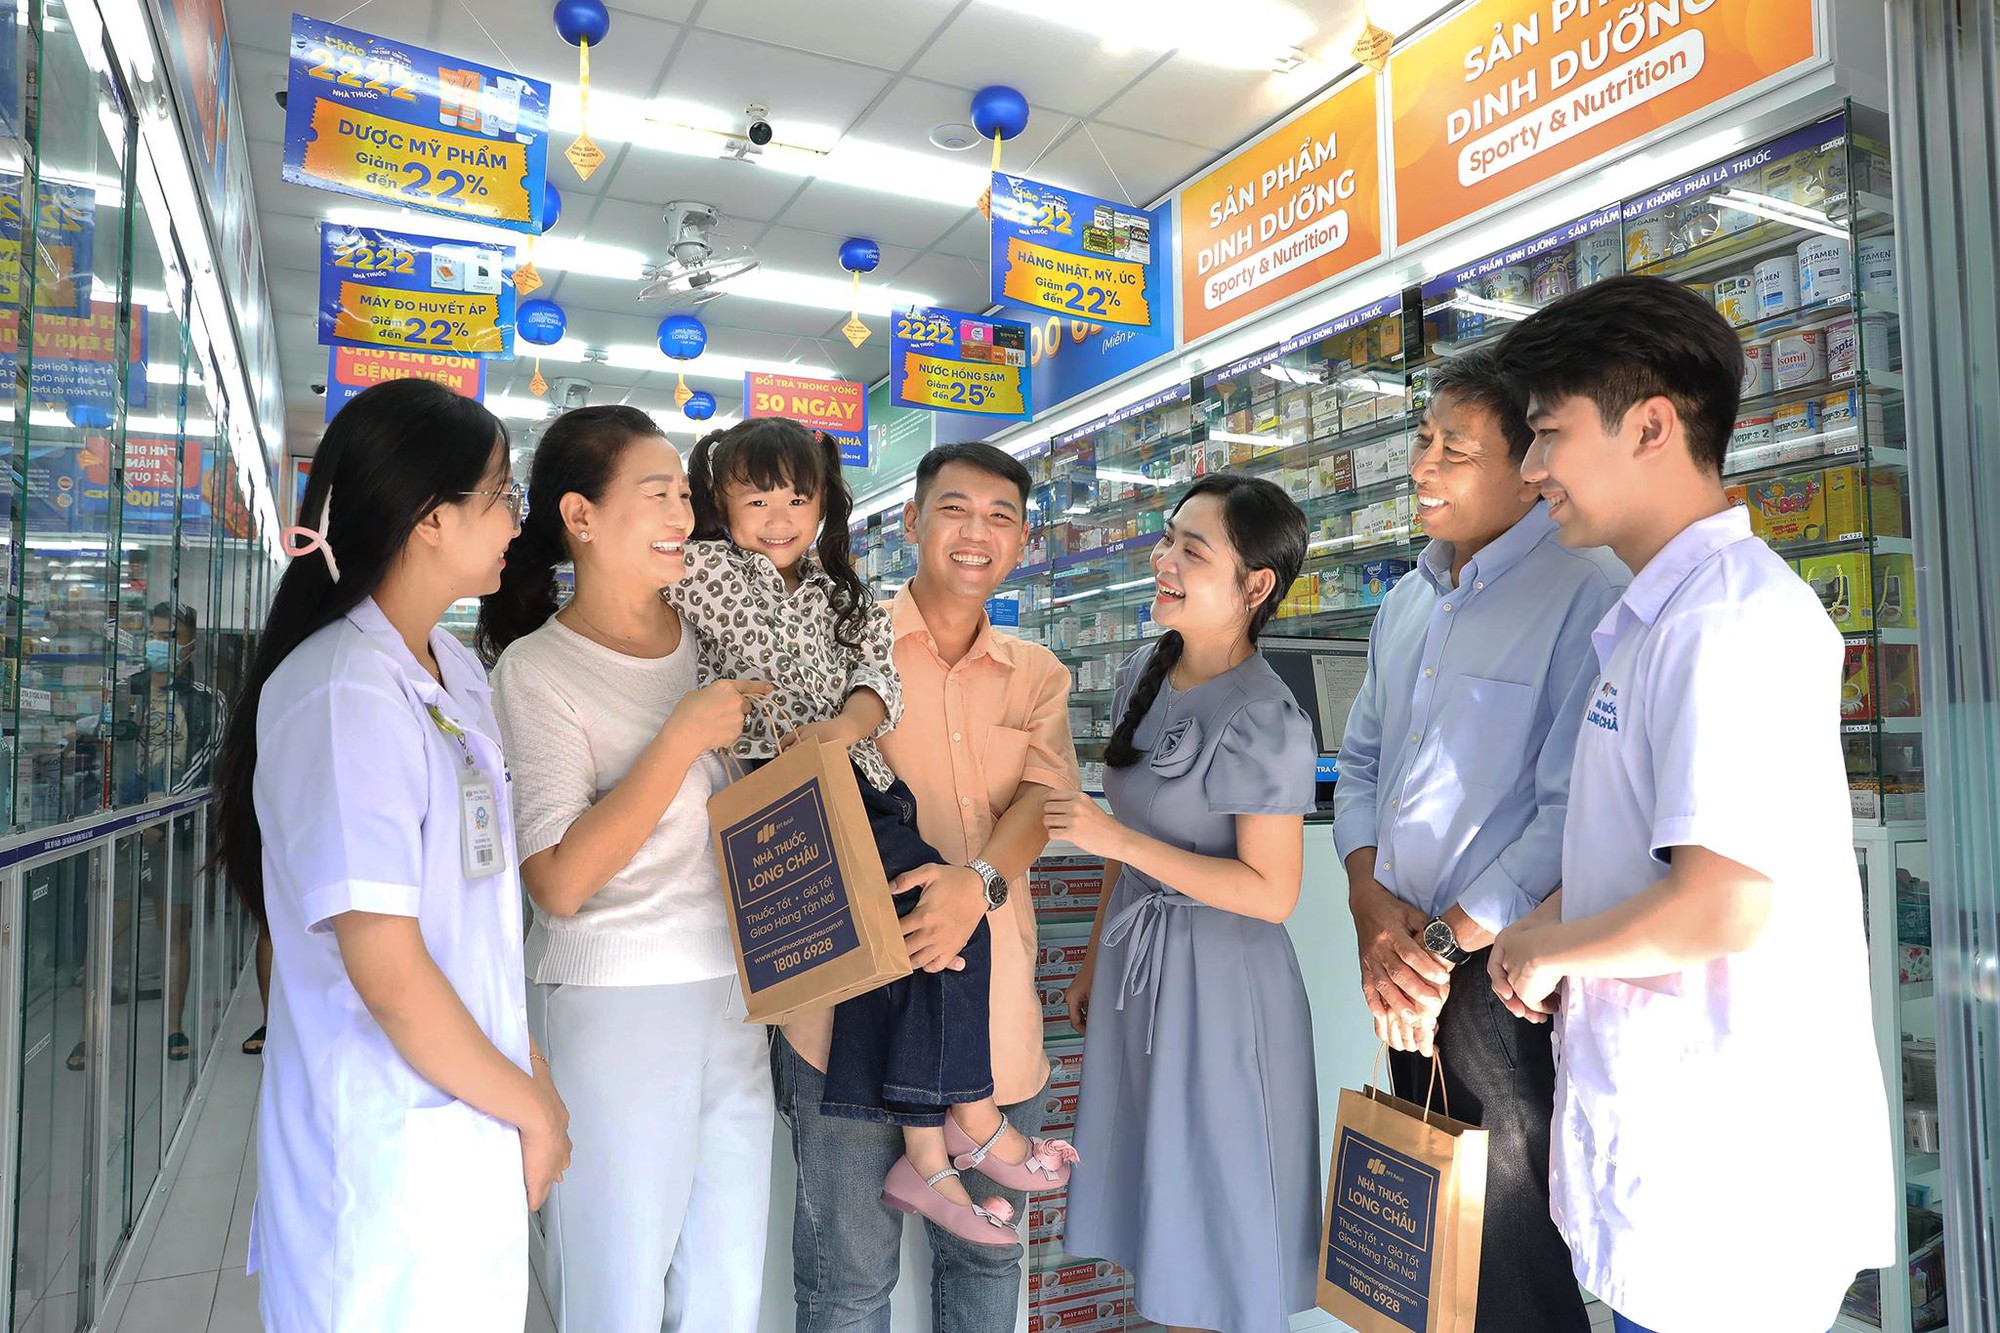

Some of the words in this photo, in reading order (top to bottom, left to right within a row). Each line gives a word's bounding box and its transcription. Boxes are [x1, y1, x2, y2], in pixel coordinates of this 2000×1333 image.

[323, 36, 366, 57] Chào
[1464, 22, 1540, 83] SẢN
[332, 89, 350, 99] NHÀ
[350, 90, 378, 100] THUỐC
[1447, 68, 1537, 145] DINH
[1470, 121, 1543, 174] Sporty
[1549, 109, 1568, 133] &
[1573, 49, 1687, 122] Nutrition
[338, 119, 404, 151] DƯỢC
[408, 138, 441, 162] MỸ
[447, 145, 507, 170] PHẨM
[355, 151, 399, 173] Giảm
[366, 173, 397, 189] đến
[401, 161, 489, 204] 22%
[1209, 182, 1255, 229] SẢN
[1261, 131, 1338, 200] PHẨM
[1623, 201, 1644, 219] NÀY
[1647, 186, 1682, 212] KHÔNG
[1684, 175, 1710, 195] PHẢI
[1714, 166, 1728, 184] LÀ
[1732, 149, 1772, 174] THUỐC
[1197, 231, 1253, 276] DINH
[1259, 168, 1356, 242] DƯỠNG
[1478, 256, 1503, 277] PHẨM
[1506, 249, 1526, 265] DINH
[1527, 235, 1558, 258] DƯỠNG
[1568, 221, 1588, 239] SẢN
[1590, 207, 1620, 230] PHẨM
[334, 246, 415, 274] 2222
[1017, 250, 1054, 270] HÀNG
[1056, 262, 1092, 280] NHẬT,
[1119, 271, 1136, 285] ÚC
[1211, 266, 1255, 301] Sporty
[1259, 255, 1271, 275] &
[1273, 223, 1339, 270] Nutrition
[1035, 276, 1063, 291] Giảm
[1042, 292, 1063, 305] đến
[1065, 283, 1121, 315] 22%
[360, 294, 391, 308] MÁY
[394, 299, 415, 311] ĐO
[419, 299, 465, 315] HUYẾT
[468, 302, 487, 315] ÁP
[906, 311, 927, 322] Chào
[378, 328, 402, 340] đến
[404, 317, 469, 345] 22%
[546, 319, 562, 327] CHÂU
[897, 319, 954, 345] 2222
[1313, 326, 1333, 341] KHÔNG
[1334, 320, 1349, 332] PHẢI
[1350, 315, 1359, 326] LÀ
[1361, 304, 1382, 320] THUỐC
[353, 361, 410, 381] BỆNH
[919, 363, 949, 377] NƯỚC
[951, 366, 981, 381] HỒNG
[983, 371, 1005, 382] SÂM
[1777, 352, 1807, 365] Isomil
[776, 378, 795, 388] TRẢ
[797, 381, 829, 392] TRONG
[831, 384, 858, 396] VÒNG
[926, 379, 949, 390] Giảm
[932, 390, 949, 400] đến
[950, 382, 996, 406] 25%
[755, 393, 785, 412] 30
[792, 396, 857, 419] NGÀY
[838, 436, 862, 446] NHÀ
[753, 848, 774, 868] NHÀ
[774, 830, 807, 857] THUỐC
[747, 866, 783, 893] LONG
[786, 843, 819, 873] CHÂU
[746, 906, 776, 926] Thuốc
[776, 897, 792, 914] Tốt
[803, 884, 819, 900] Giá
[819, 875, 833, 891] Tốt
[750, 921, 774, 940] Giao
[774, 911, 802, 934] Hàng
[802, 901, 821, 917] Tận
[821, 891, 836, 905] Nơi
[754, 918, 844, 965] www.nhathuoclongchau.com.vn
[773, 950, 801, 974] 1800
[803, 937, 834, 962] 6928
[1357, 1174, 1377, 1194] NHÀ
[1378, 1184, 1410, 1210] THUỐC
[1348, 1187, 1380, 1214] LONG
[1382, 1204, 1417, 1235] CHÂU
[1338, 1216, 1363, 1238] Thuốc
[1363, 1229, 1378, 1247] Tốt
[1388, 1244, 1403, 1259] Giá
[1404, 1253, 1420, 1270] Tốt
[1338, 1231, 1358, 1249] Giao
[1358, 1243, 1382, 1266] Hàng
[1382, 1254, 1401, 1275] Tận
[1401, 1265, 1417, 1283] Nơi
[1335, 1256, 1418, 1308] www.nhathuoclongchau.com.vn
[1348, 1272, 1371, 1298] 1800
[1372, 1290, 1402, 1314] 6928
